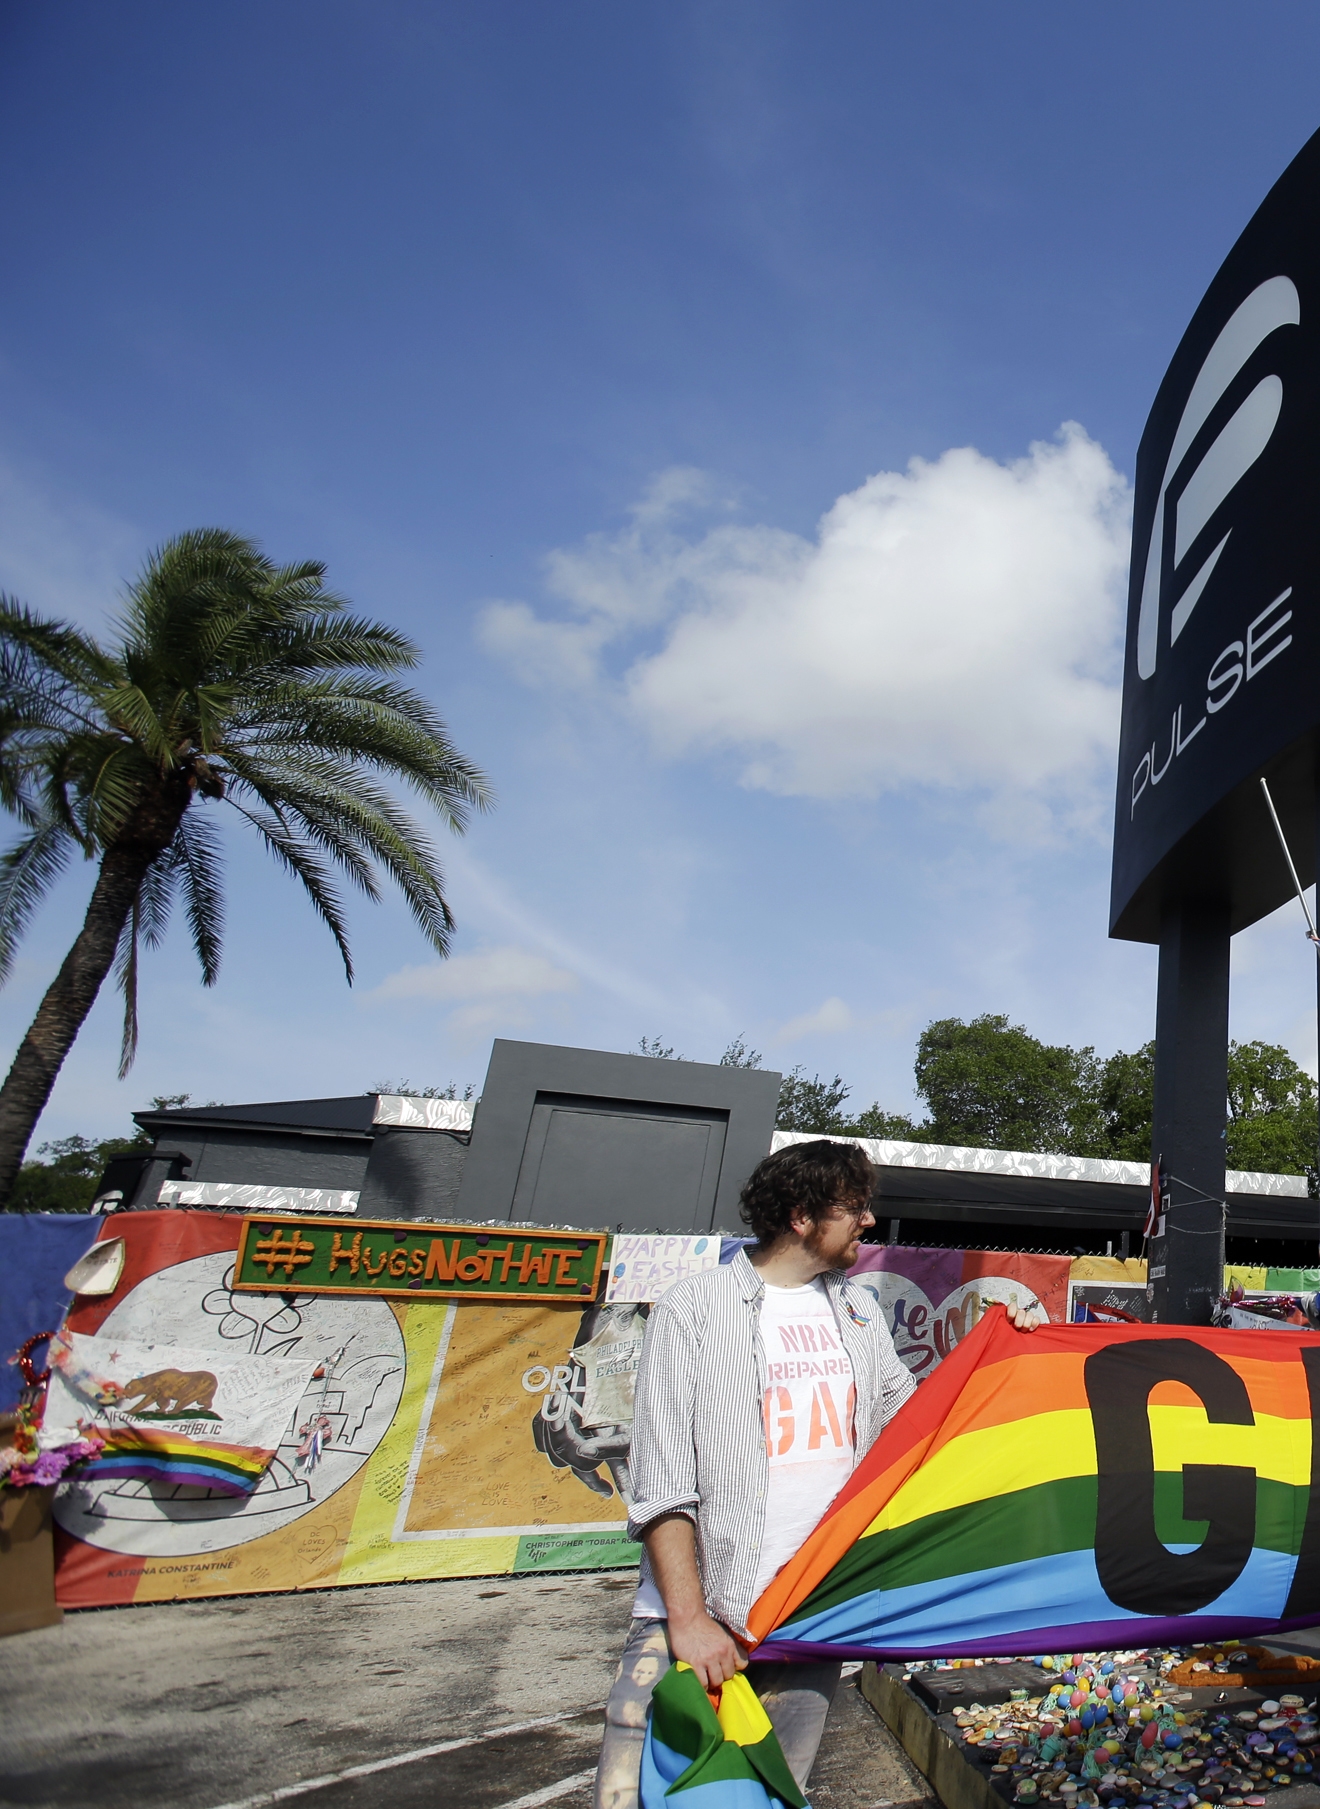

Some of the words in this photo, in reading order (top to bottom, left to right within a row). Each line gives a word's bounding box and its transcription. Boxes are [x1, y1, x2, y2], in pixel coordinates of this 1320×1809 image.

[1131, 586, 1293, 822] PULSE
[616, 1237, 692, 1260] HAPPY
[768, 1358, 851, 1382] REPARE
[521, 1365, 587, 1394] ORL
[486, 1482, 510, 1491] LOVE
[482, 1497, 508, 1506] LOVE
[303, 1538, 326, 1546] LOVES
[525, 1540, 584, 1550] CHRISTOPHER
[107, 1567, 156, 1578] KATRINA
[159, 1561, 234, 1575] CONSTANTINE
